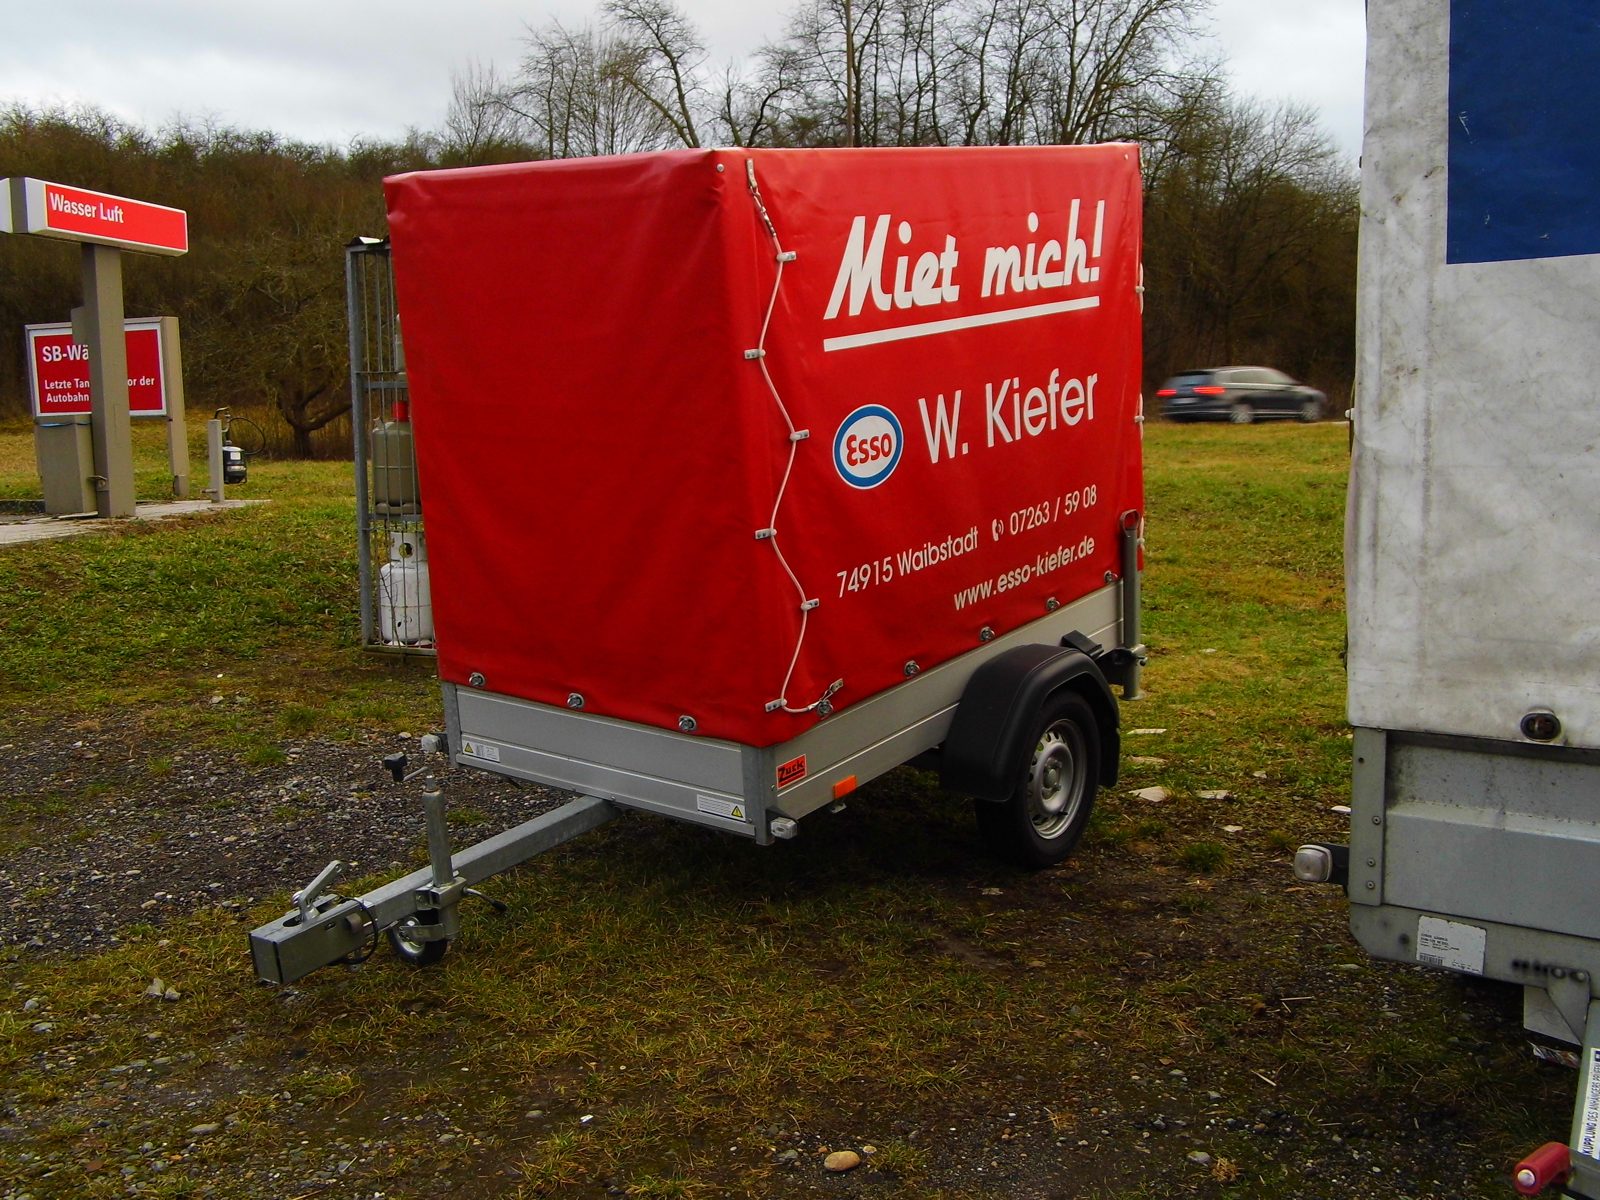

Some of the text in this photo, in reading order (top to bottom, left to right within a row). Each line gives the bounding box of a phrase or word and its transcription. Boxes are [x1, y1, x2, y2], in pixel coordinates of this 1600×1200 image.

[50, 192, 124, 224] Wasser Luft
[823, 198, 1105, 320] Miet mich!
[42, 344, 89, 362] SB-Wä
[44, 375, 155, 390] Letzte Tan or der
[46, 392, 90, 403] Autobahn
[917, 367, 1098, 464] W. Kiefer
[836, 556, 893, 598] 74915
[897, 525, 979, 577] Waibstadt
[1009, 500, 1050, 536] 07263
[953, 535, 1095, 611] www.esso-kiefer.de
